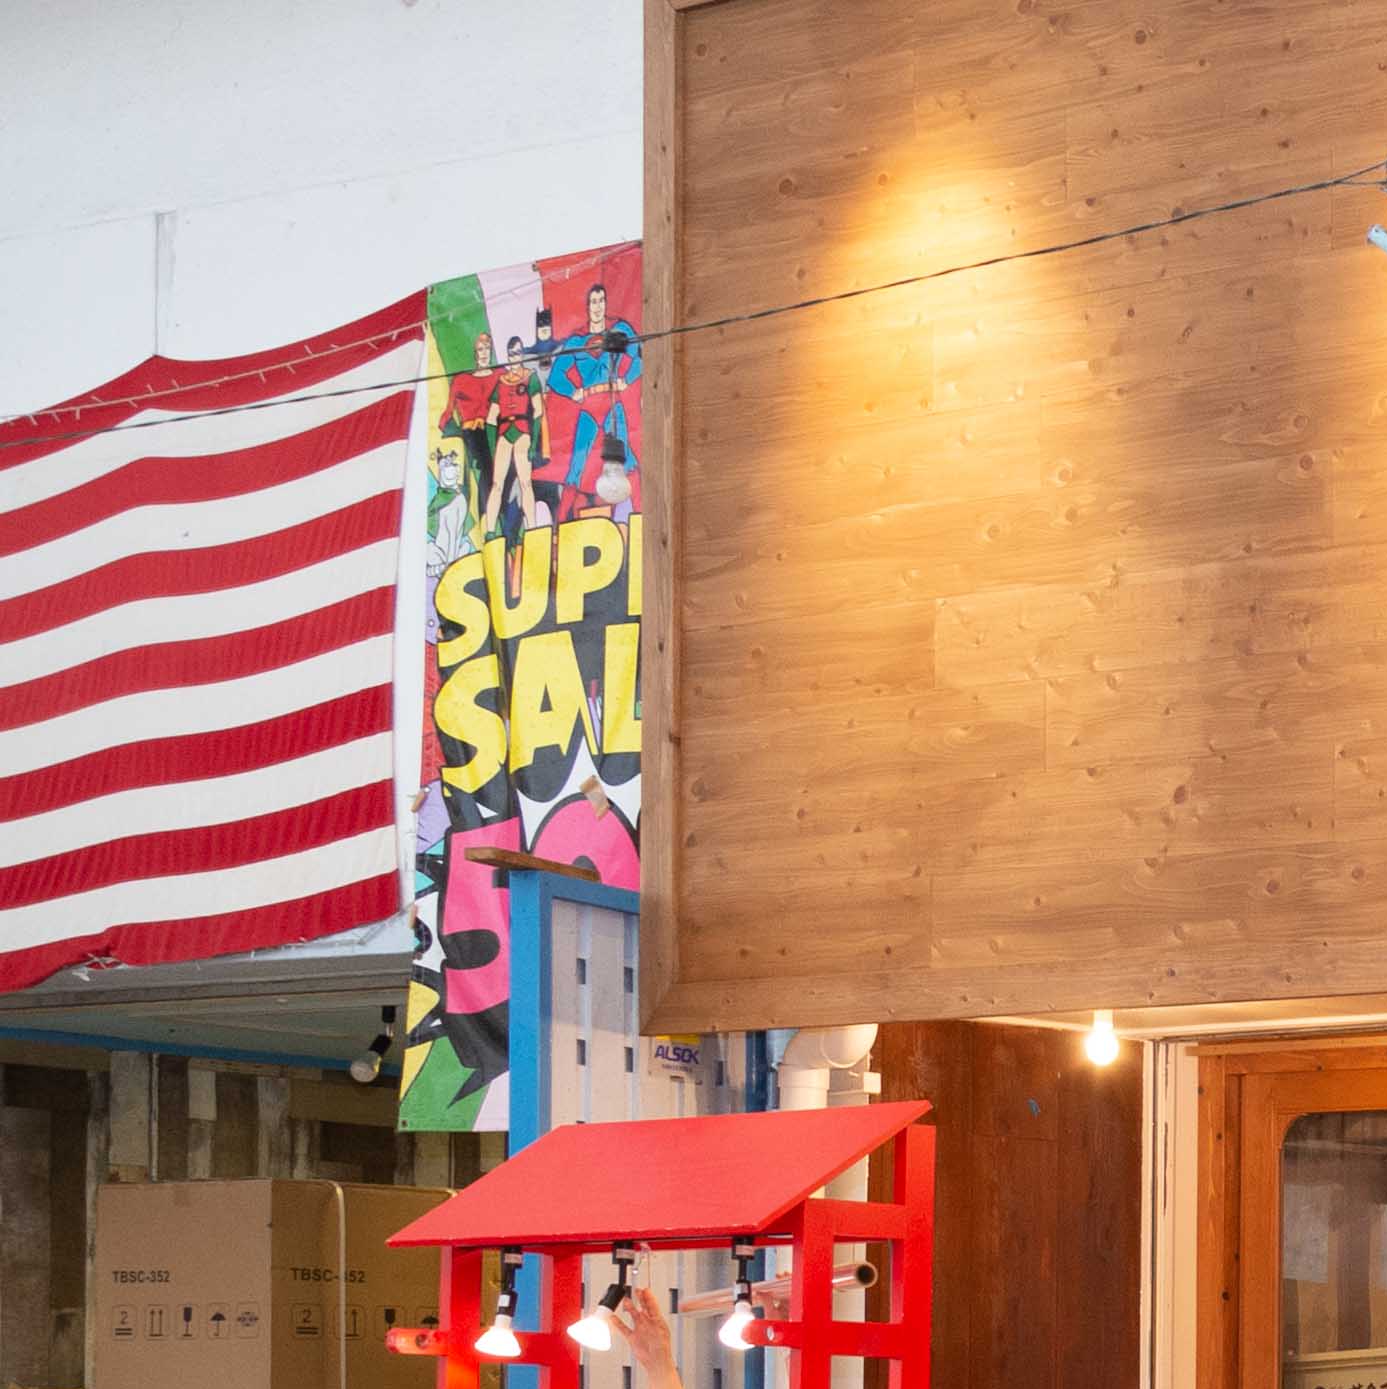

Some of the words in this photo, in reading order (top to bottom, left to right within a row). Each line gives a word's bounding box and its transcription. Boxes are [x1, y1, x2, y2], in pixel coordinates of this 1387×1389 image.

[434, 512, 642, 668] SUP
[655, 1045, 699, 1064] ALSOK
[112, 1270, 171, 1284] TBSC-352
